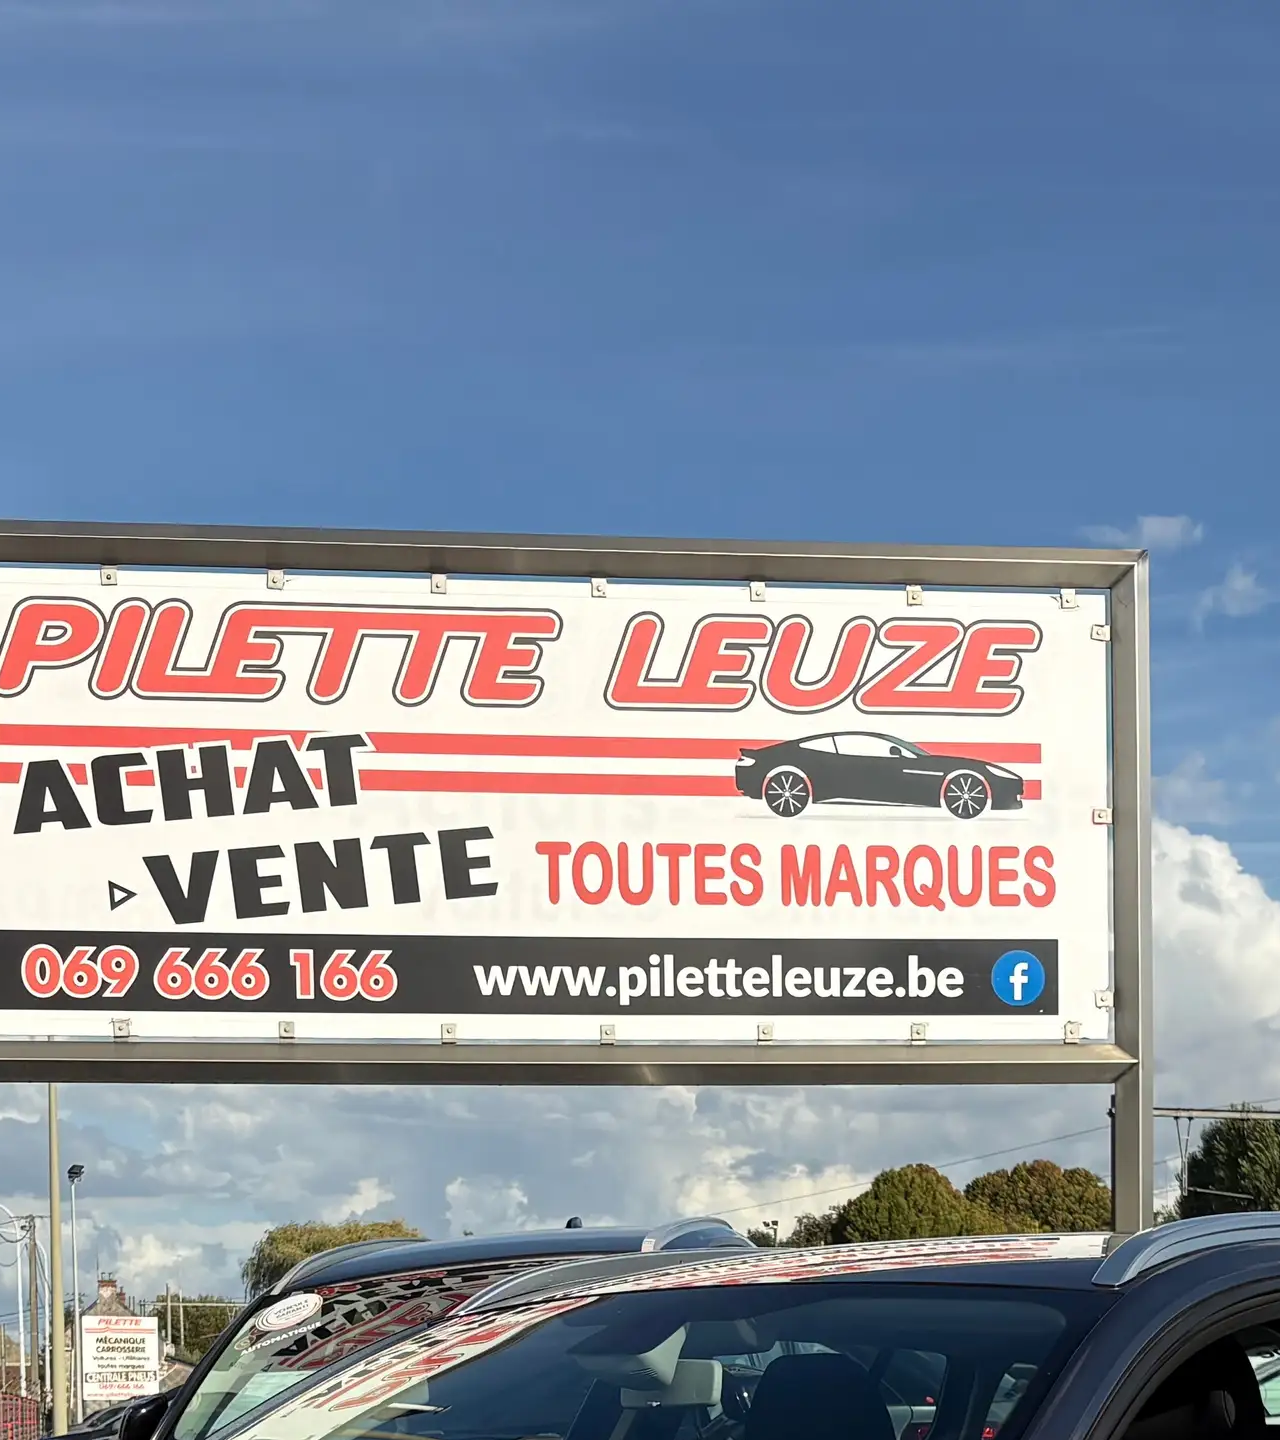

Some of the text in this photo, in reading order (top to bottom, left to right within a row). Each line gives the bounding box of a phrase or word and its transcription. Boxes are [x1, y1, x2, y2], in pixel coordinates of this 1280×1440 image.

[603, 611, 1043, 718] LEUZE
[11, 731, 374, 835] ACHAT
[143, 827, 499, 925] VENTE
[535, 840, 1057, 914] TOUTES MARQUES
[20, 944, 399, 1002] 069 666 166
[473, 954, 965, 1007] www.piletteleuze.be
[98, 1318, 141, 1326] PILETTE
[240, 1321, 322, 1356] AUTOMATIQUE
[87, 1372, 155, 1382] CENTRALE PNEUS
